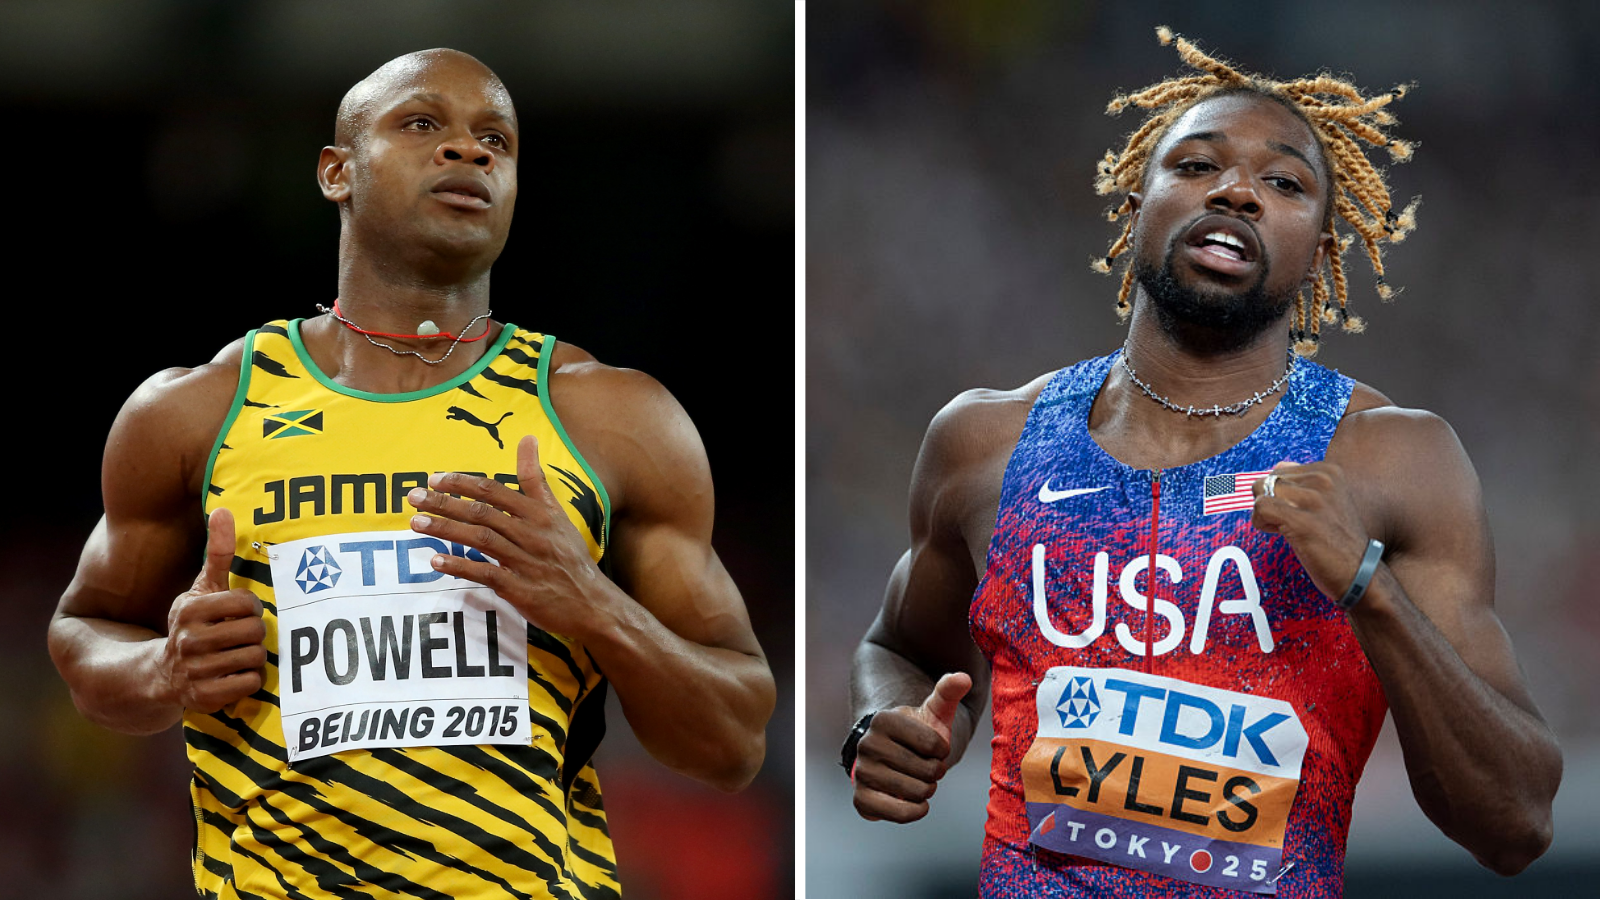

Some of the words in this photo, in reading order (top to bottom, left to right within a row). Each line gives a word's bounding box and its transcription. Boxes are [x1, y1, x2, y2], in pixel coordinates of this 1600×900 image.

[253, 471, 525, 526] JAMA
[1031, 542, 1275, 656] USA
[290, 609, 514, 693] POWELL
[299, 706, 435, 752] BEIJING
[442, 705, 519, 738] 2015
[1104, 678, 1292, 767] TDK
[1050, 746, 1262, 833] LYLES
